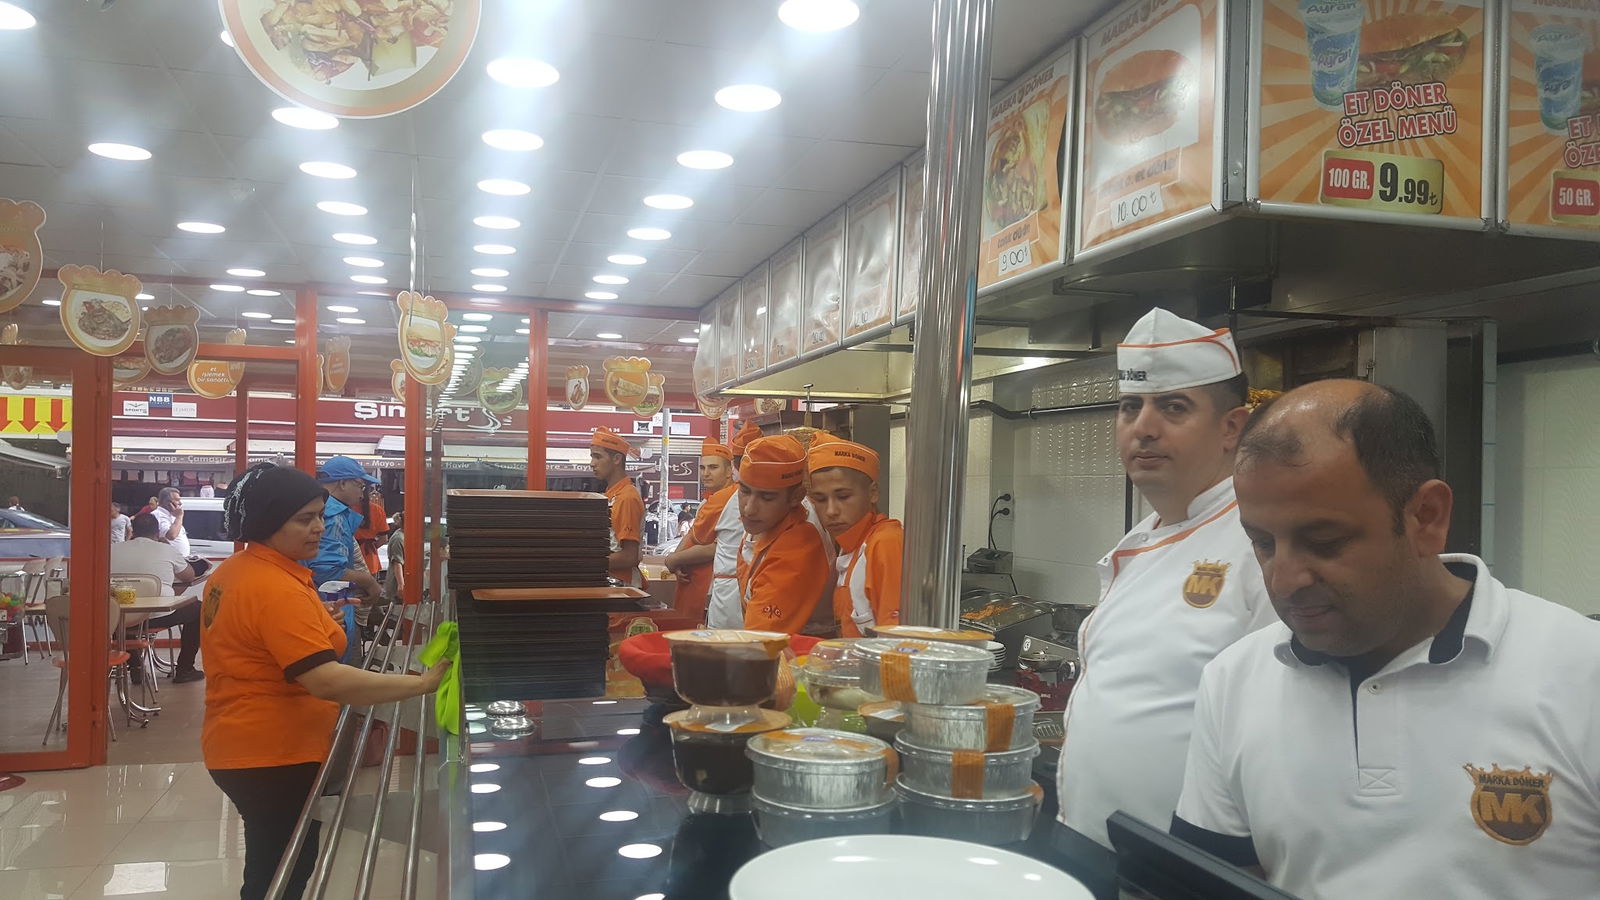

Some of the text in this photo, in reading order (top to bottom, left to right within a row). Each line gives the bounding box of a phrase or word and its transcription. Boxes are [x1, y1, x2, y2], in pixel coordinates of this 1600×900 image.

[1343, 81, 1448, 116] ET DÖNER
[1338, 105, 1457, 148] ÖZEL MENÜ
[1567, 115, 1592, 139] ET
[1328, 168, 1370, 190] 100 GR.
[1559, 187, 1594, 206] 50 GR.
[148, 455, 177, 463] Çorap
[188, 455, 227, 464] Çamaşır
[1479, 774, 1545, 788] MARKA DÖNER
[1479, 791, 1545, 824] MK
